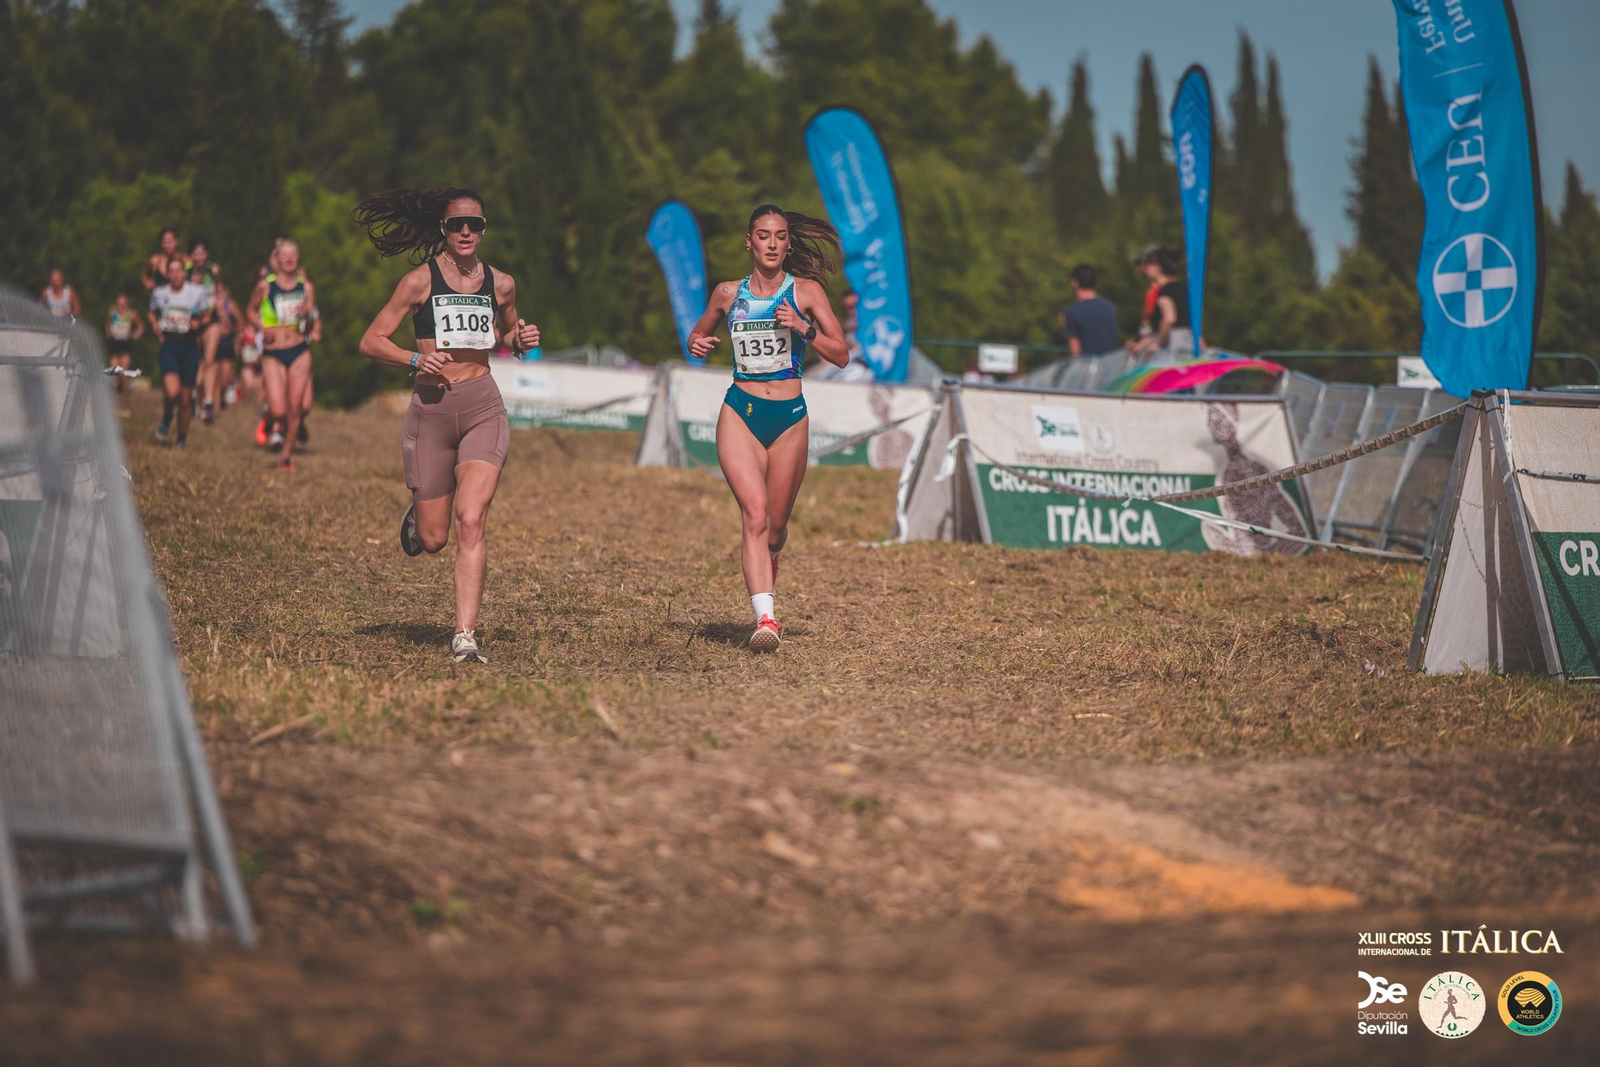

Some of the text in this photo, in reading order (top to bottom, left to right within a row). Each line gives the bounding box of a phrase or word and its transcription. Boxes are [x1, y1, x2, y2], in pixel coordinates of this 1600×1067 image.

[441, 313, 490, 333] 1108
[739, 337, 788, 357] 1352
[988, 467, 1192, 499] CROSS INTERNACIONAL
[1046, 497, 1162, 547] ITÁLICA
